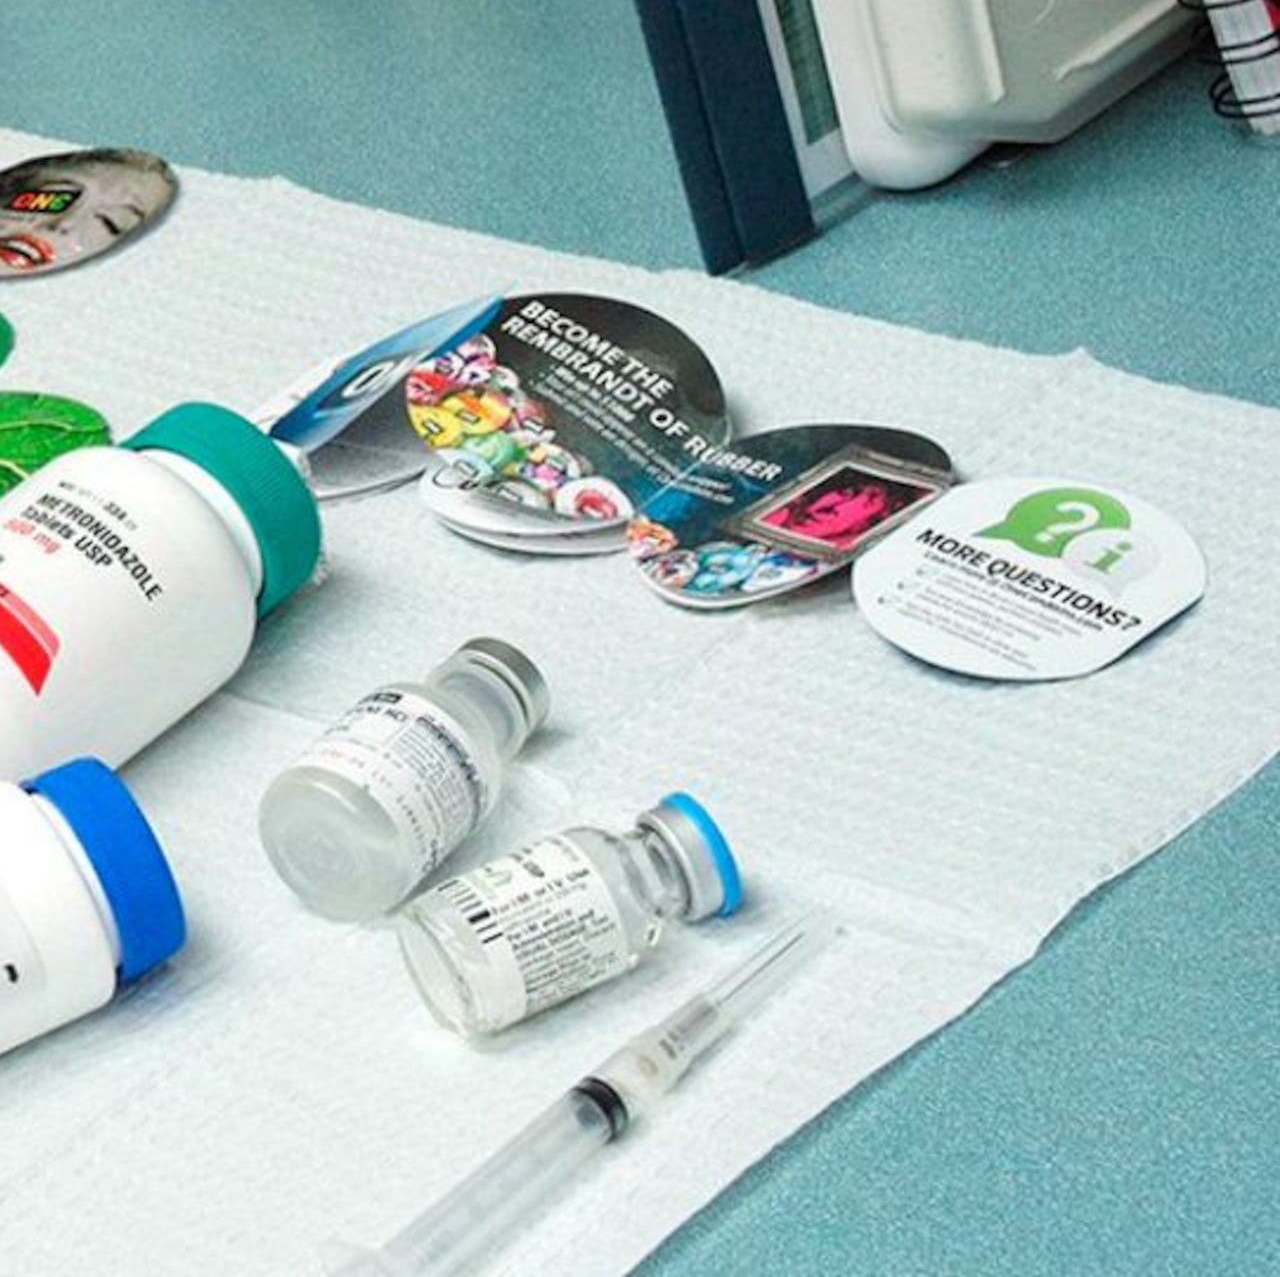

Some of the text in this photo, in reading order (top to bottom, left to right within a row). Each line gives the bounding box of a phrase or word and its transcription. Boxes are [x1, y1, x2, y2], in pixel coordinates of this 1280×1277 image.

[12, 192, 73, 211] ONE
[501, 317, 782, 481] REMBRANDT OF RUBBER
[520, 301, 674, 399] BECOME THE
[22, 506, 114, 568] tablets USP
[37, 493, 163, 601] METRONIDAZOLE
[916, 529, 991, 567] MORE
[987, 557, 1142, 631] QUESTIONS?
